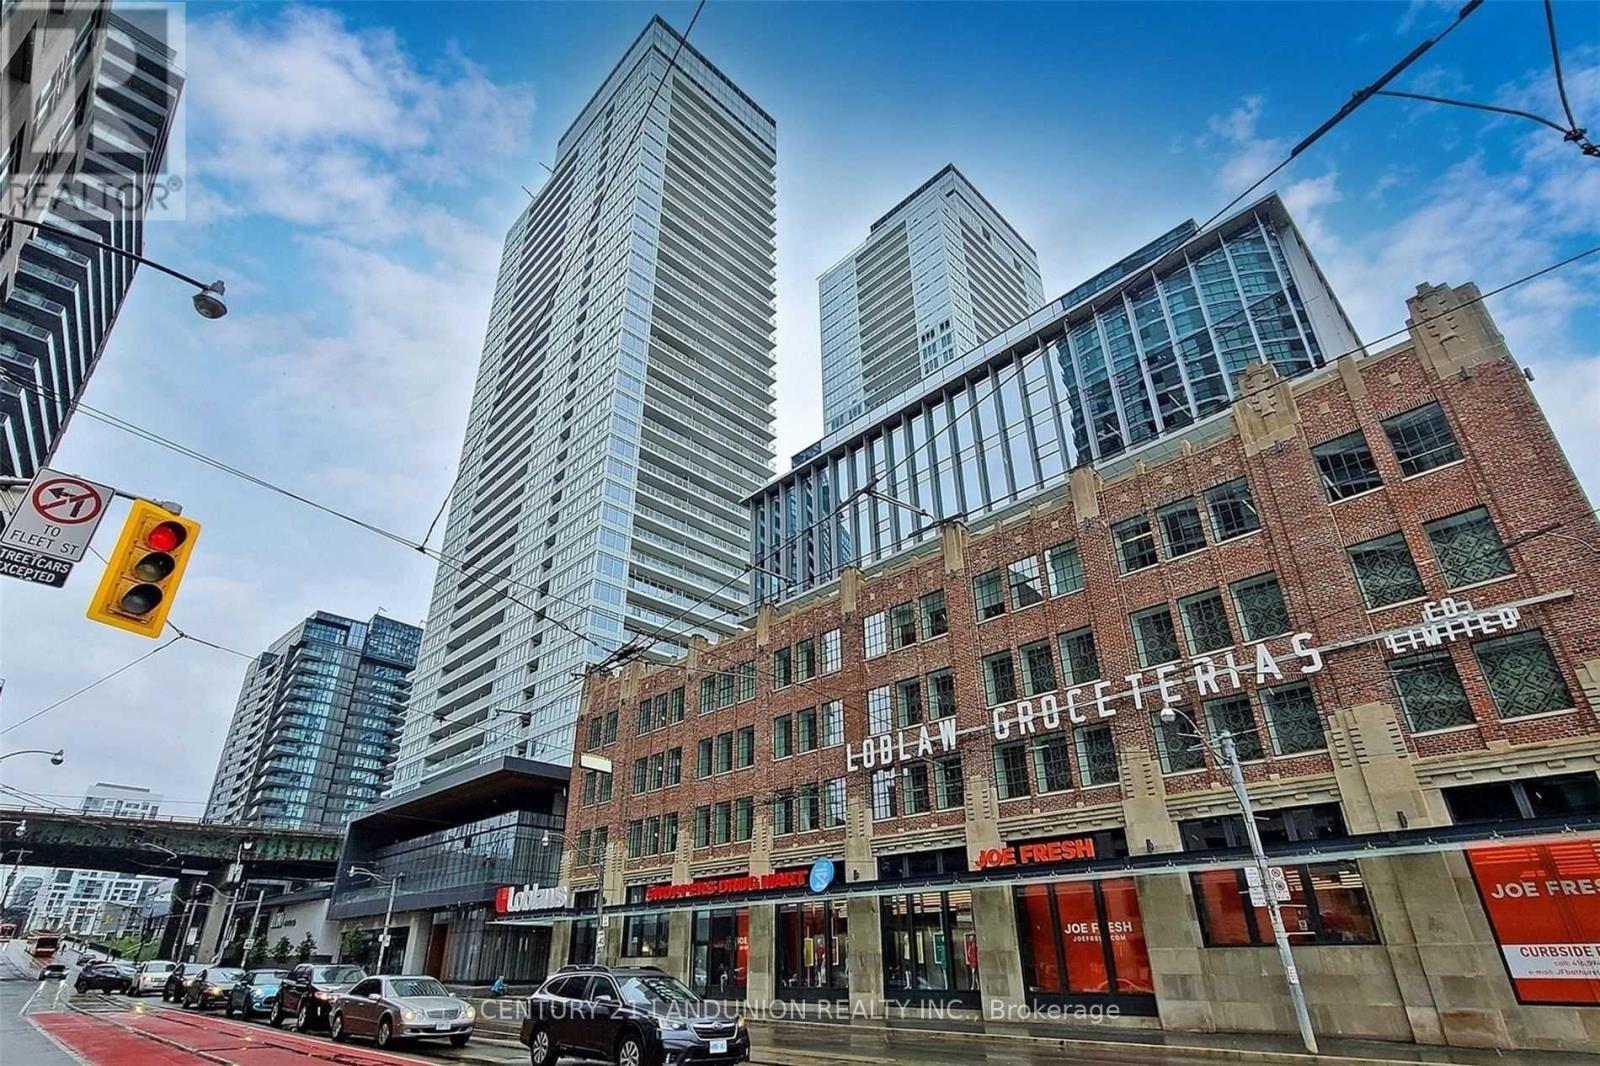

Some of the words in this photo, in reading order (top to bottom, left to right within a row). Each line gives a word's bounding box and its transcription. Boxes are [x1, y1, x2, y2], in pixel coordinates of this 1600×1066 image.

[10, 529, 55, 550] FLEET
[60, 542, 79, 556] ST
[44, 524, 61, 538] TO
[0, 548, 70, 574] TREETCARS
[0, 561, 55, 583] XCEPTED
[1384, 606, 1521, 654] LIMITED
[846, 718, 957, 772] LOBLAW
[991, 632, 1324, 741] GROCETERIAS
[975, 846, 1017, 869] JOE
[1019, 837, 1096, 864] FRESH
[1491, 881, 1540, 898] JOE
[1064, 923, 1088, 934] JOE
[1091, 921, 1133, 934] FESH
[1519, 946, 1594, 957] CURBSIDE
